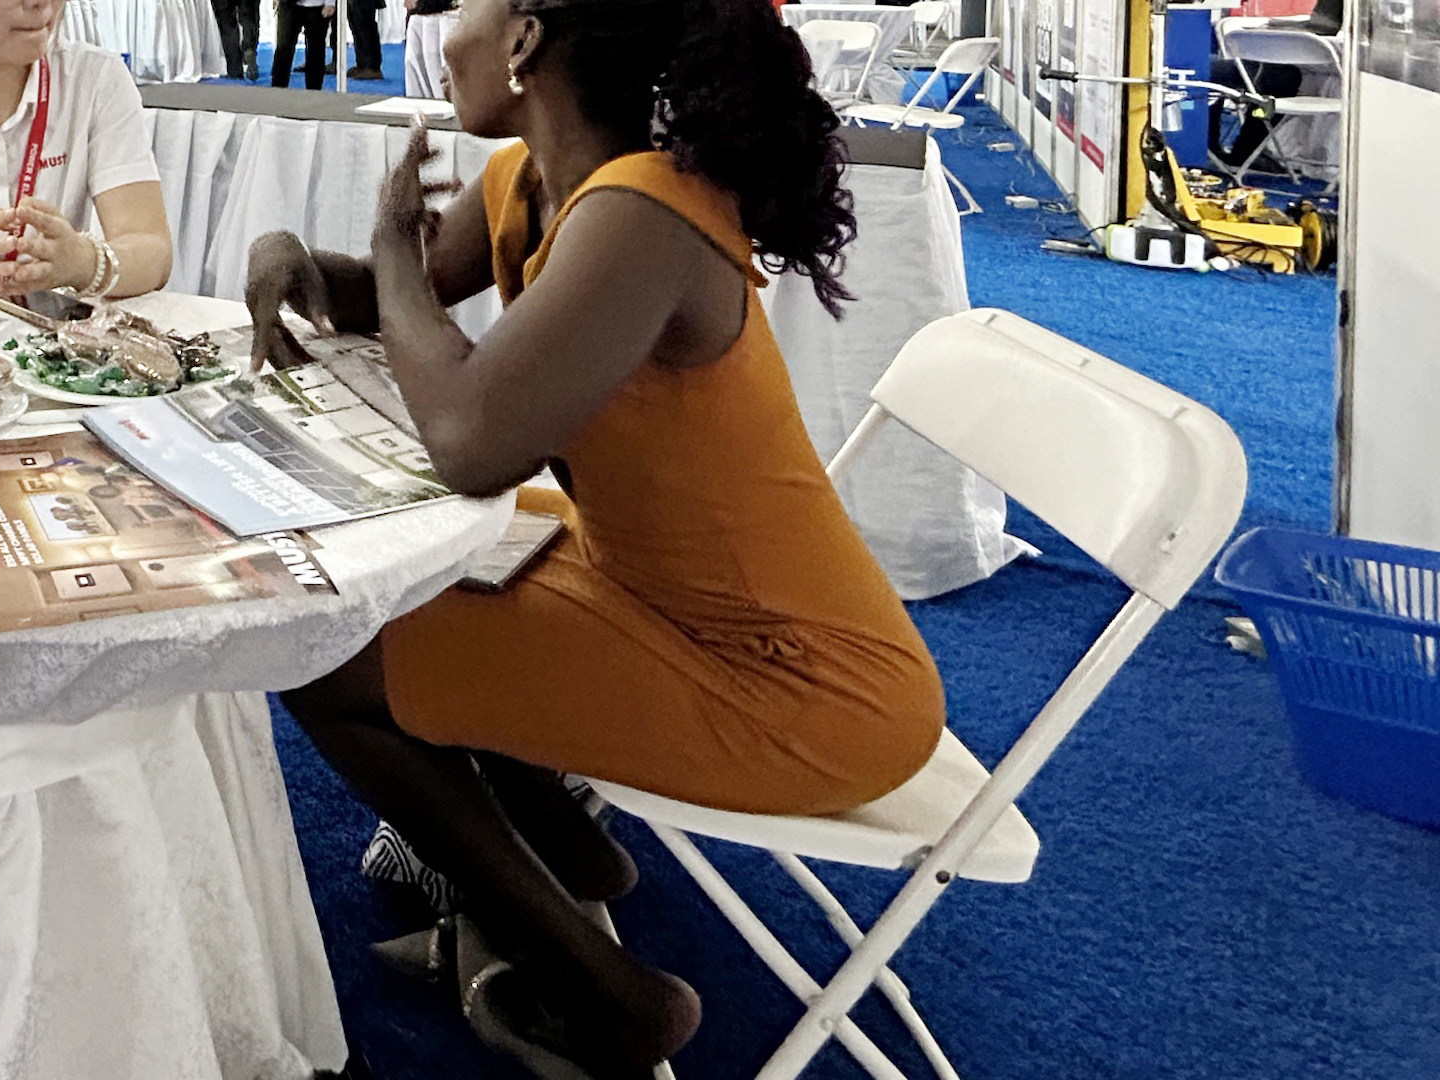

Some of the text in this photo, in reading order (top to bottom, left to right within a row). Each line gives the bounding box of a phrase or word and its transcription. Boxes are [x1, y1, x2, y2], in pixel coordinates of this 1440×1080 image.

[25, 143, 39, 174] POWER
[39, 154, 68, 169] MUST
[261, 531, 327, 585] MUST
